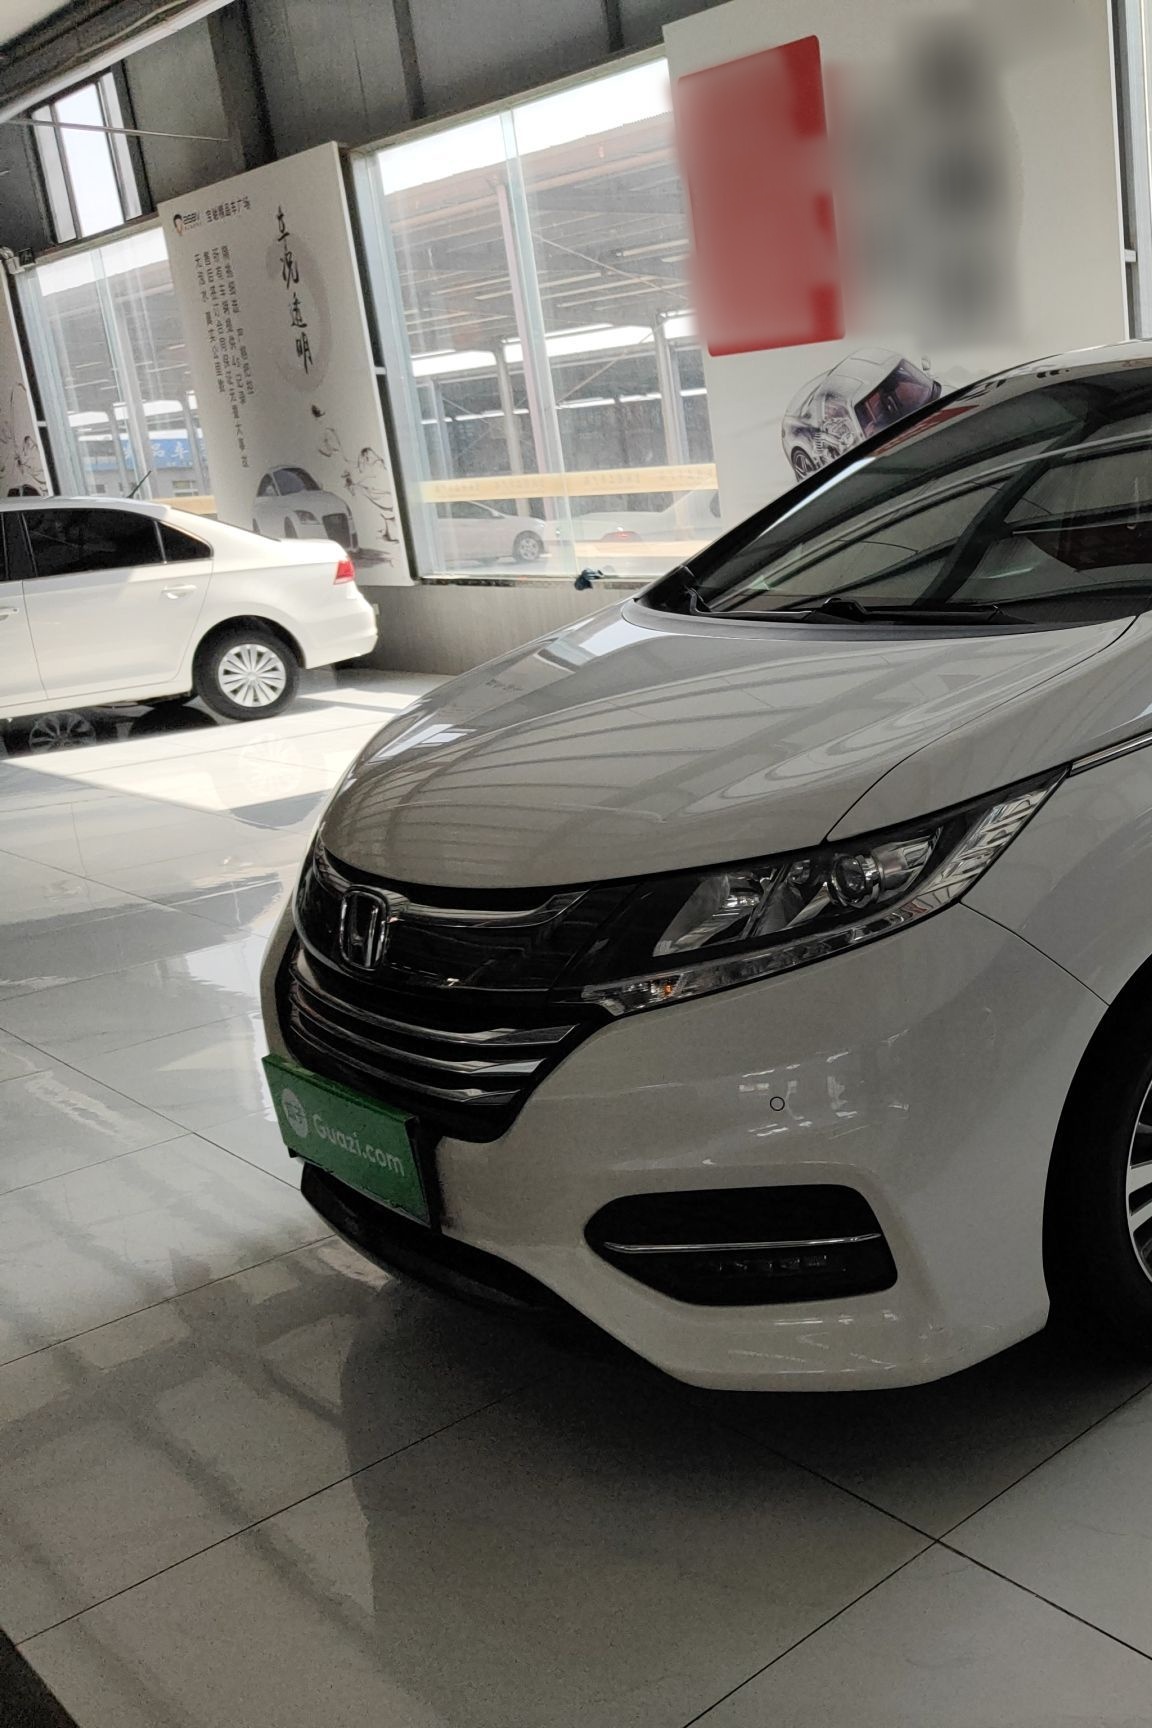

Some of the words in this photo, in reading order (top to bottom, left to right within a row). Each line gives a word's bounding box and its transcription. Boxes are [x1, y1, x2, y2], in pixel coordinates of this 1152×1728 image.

[276, 205, 313, 375] 车况透明
[312, 1113, 406, 1177] Guazi.com
